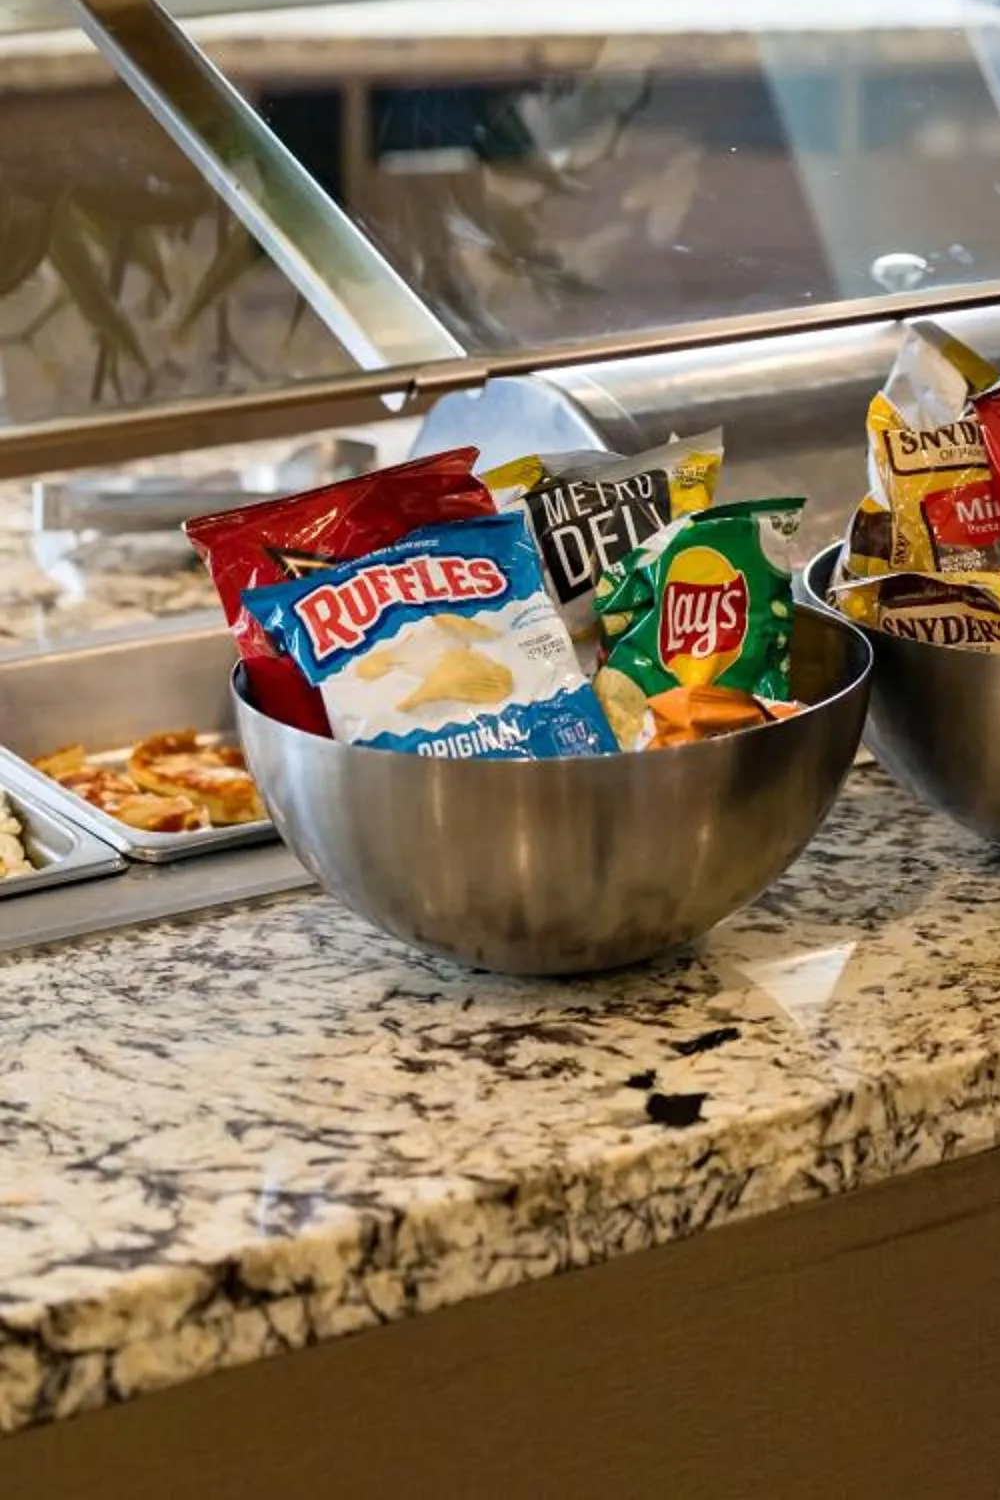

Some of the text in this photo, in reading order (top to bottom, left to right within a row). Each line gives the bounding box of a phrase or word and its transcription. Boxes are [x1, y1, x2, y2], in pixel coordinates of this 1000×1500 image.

[900, 420, 986, 455] SNYD
[295, 555, 509, 660] RUFFLES
[666, 579, 744, 658] Lay's
